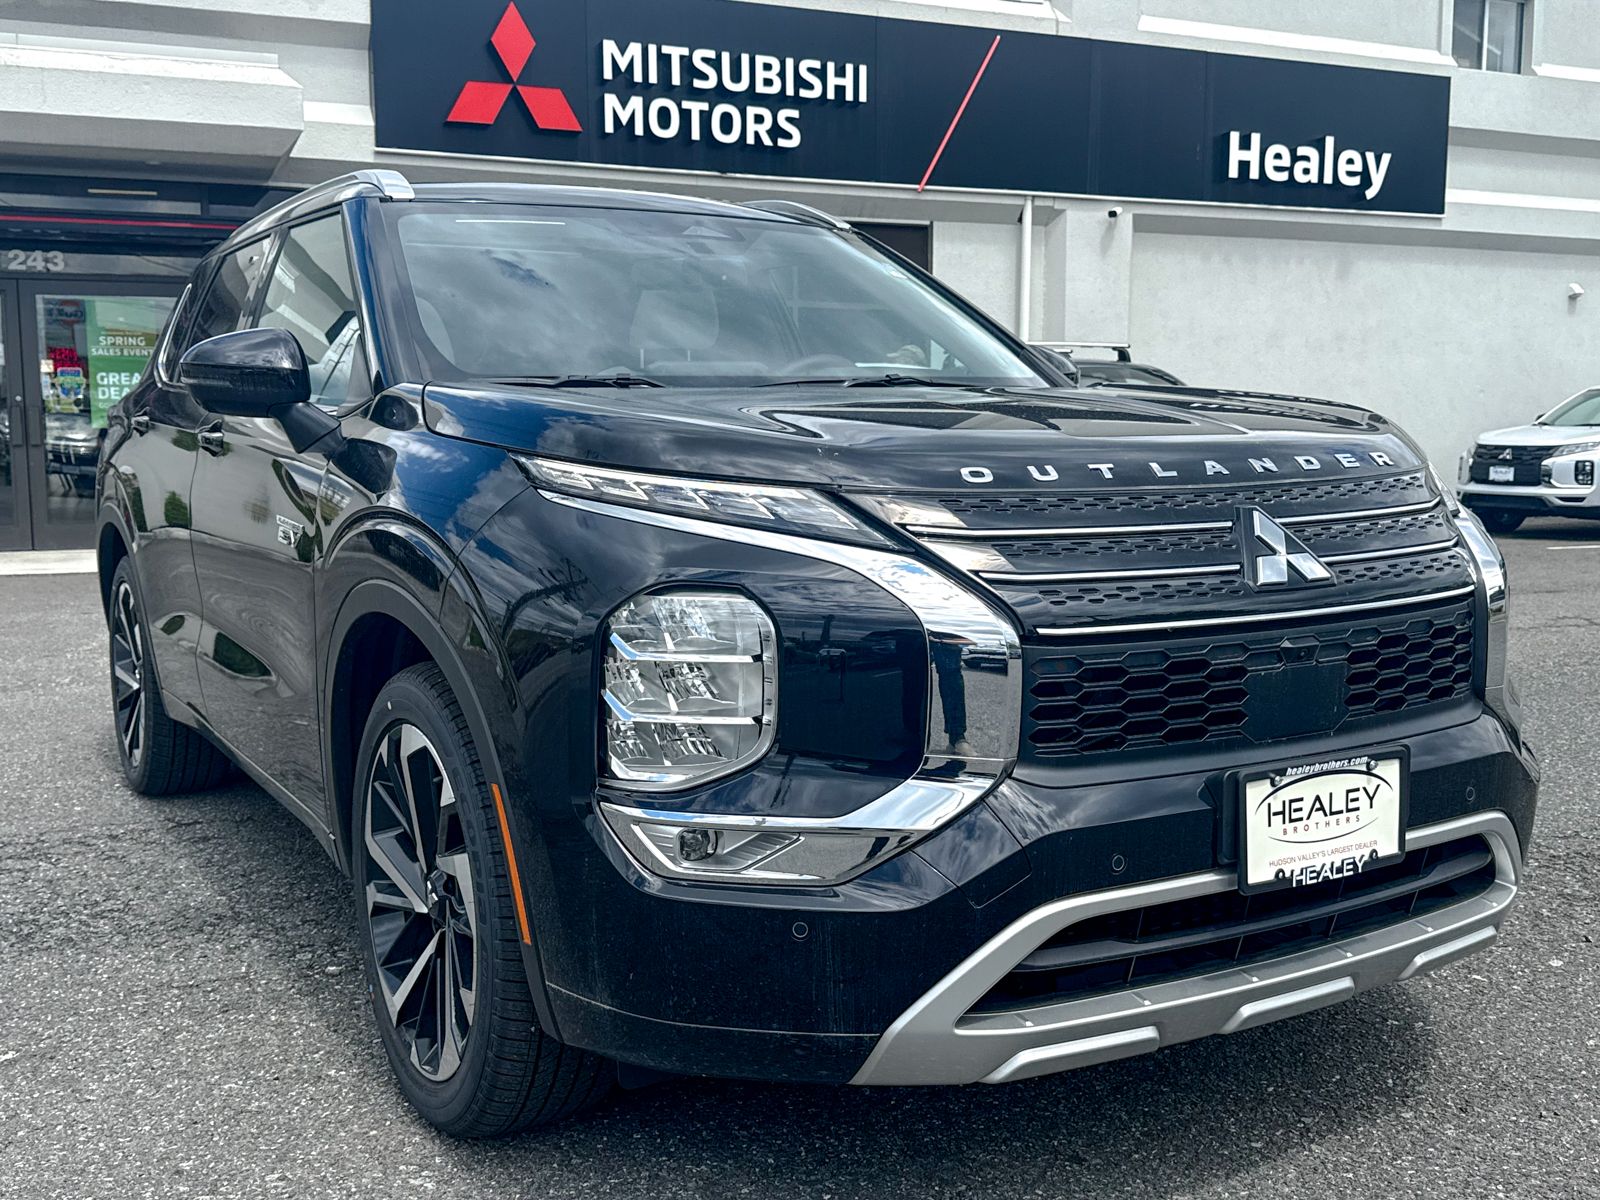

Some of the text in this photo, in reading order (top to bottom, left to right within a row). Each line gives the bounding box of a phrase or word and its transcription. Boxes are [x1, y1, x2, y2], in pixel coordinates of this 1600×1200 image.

[602, 38, 867, 103] MITSUBISHI
[603, 93, 802, 148] MOTORS
[1228, 130, 1392, 200] Healey
[7, 248, 65, 271] 243
[91, 347, 153, 356] SALES EVENT
[98, 335, 146, 346] SPRING
[96, 372, 142, 385] GREA
[97, 386, 131, 400] DEA
[959, 451, 1395, 484] OUTLANDER
[1286, 756, 1369, 776] healeybrothers.com
[1268, 784, 1380, 827] HEALEY
[1282, 815, 1361, 836] BROTHERS
[1269, 840, 1378, 868] HUDSON VALLEY'S LARGEST DEALER
[1292, 855, 1366, 887] HEALEY
